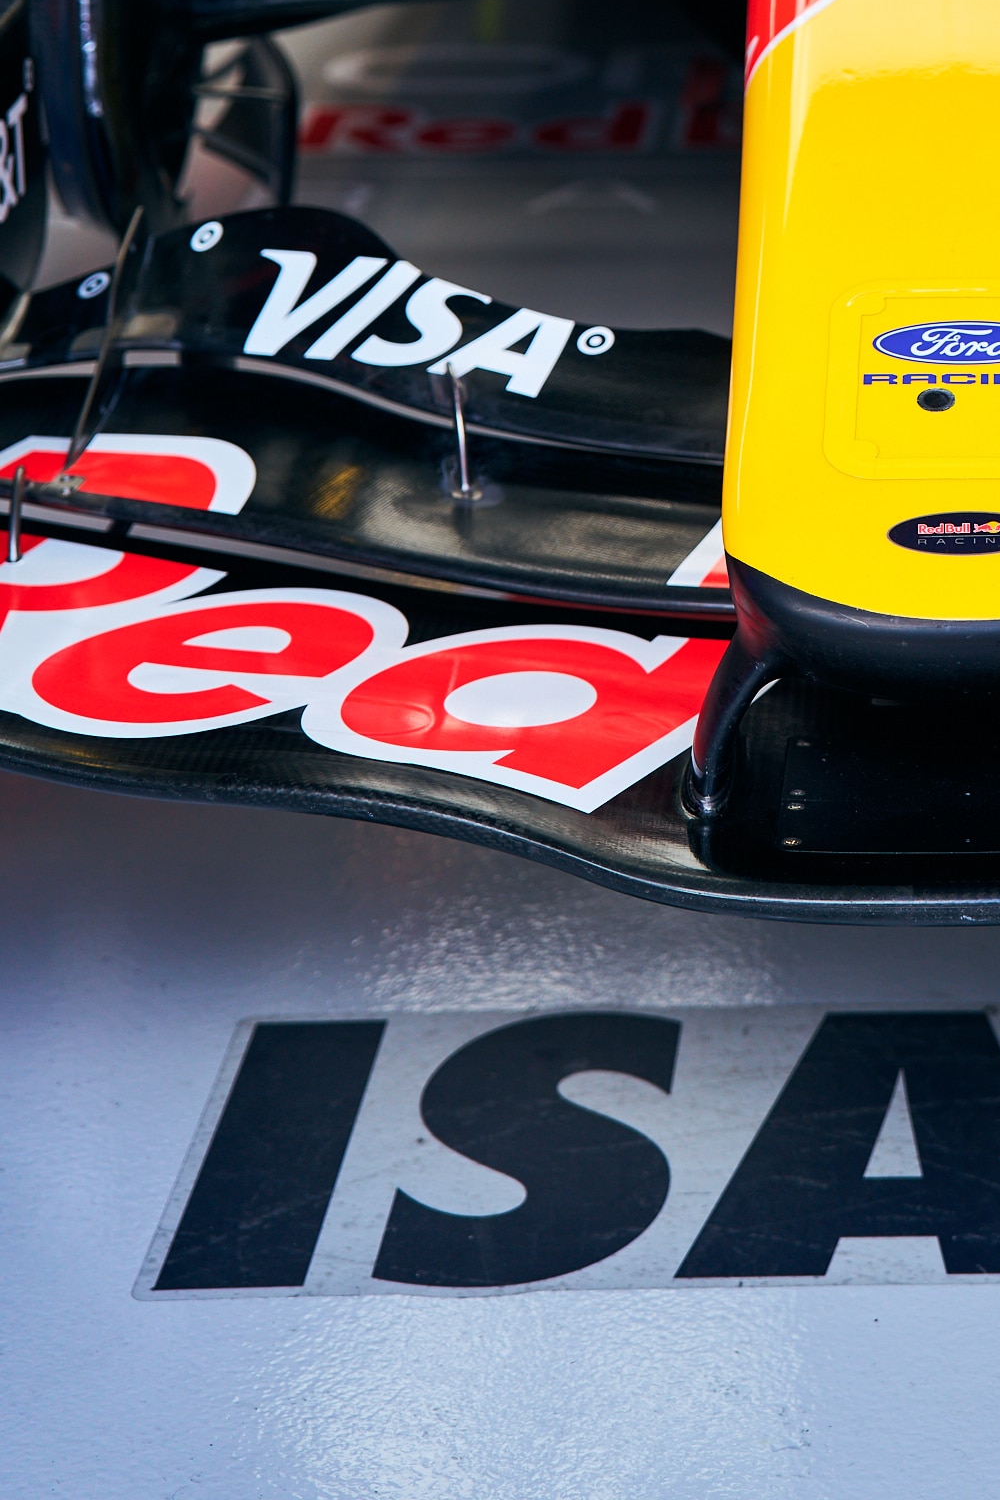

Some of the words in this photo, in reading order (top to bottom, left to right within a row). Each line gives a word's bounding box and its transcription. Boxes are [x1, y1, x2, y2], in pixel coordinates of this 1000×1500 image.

[243, 248, 576, 398] VISA
[917, 523, 944, 535] Red
[945, 522, 970, 534] Bull
